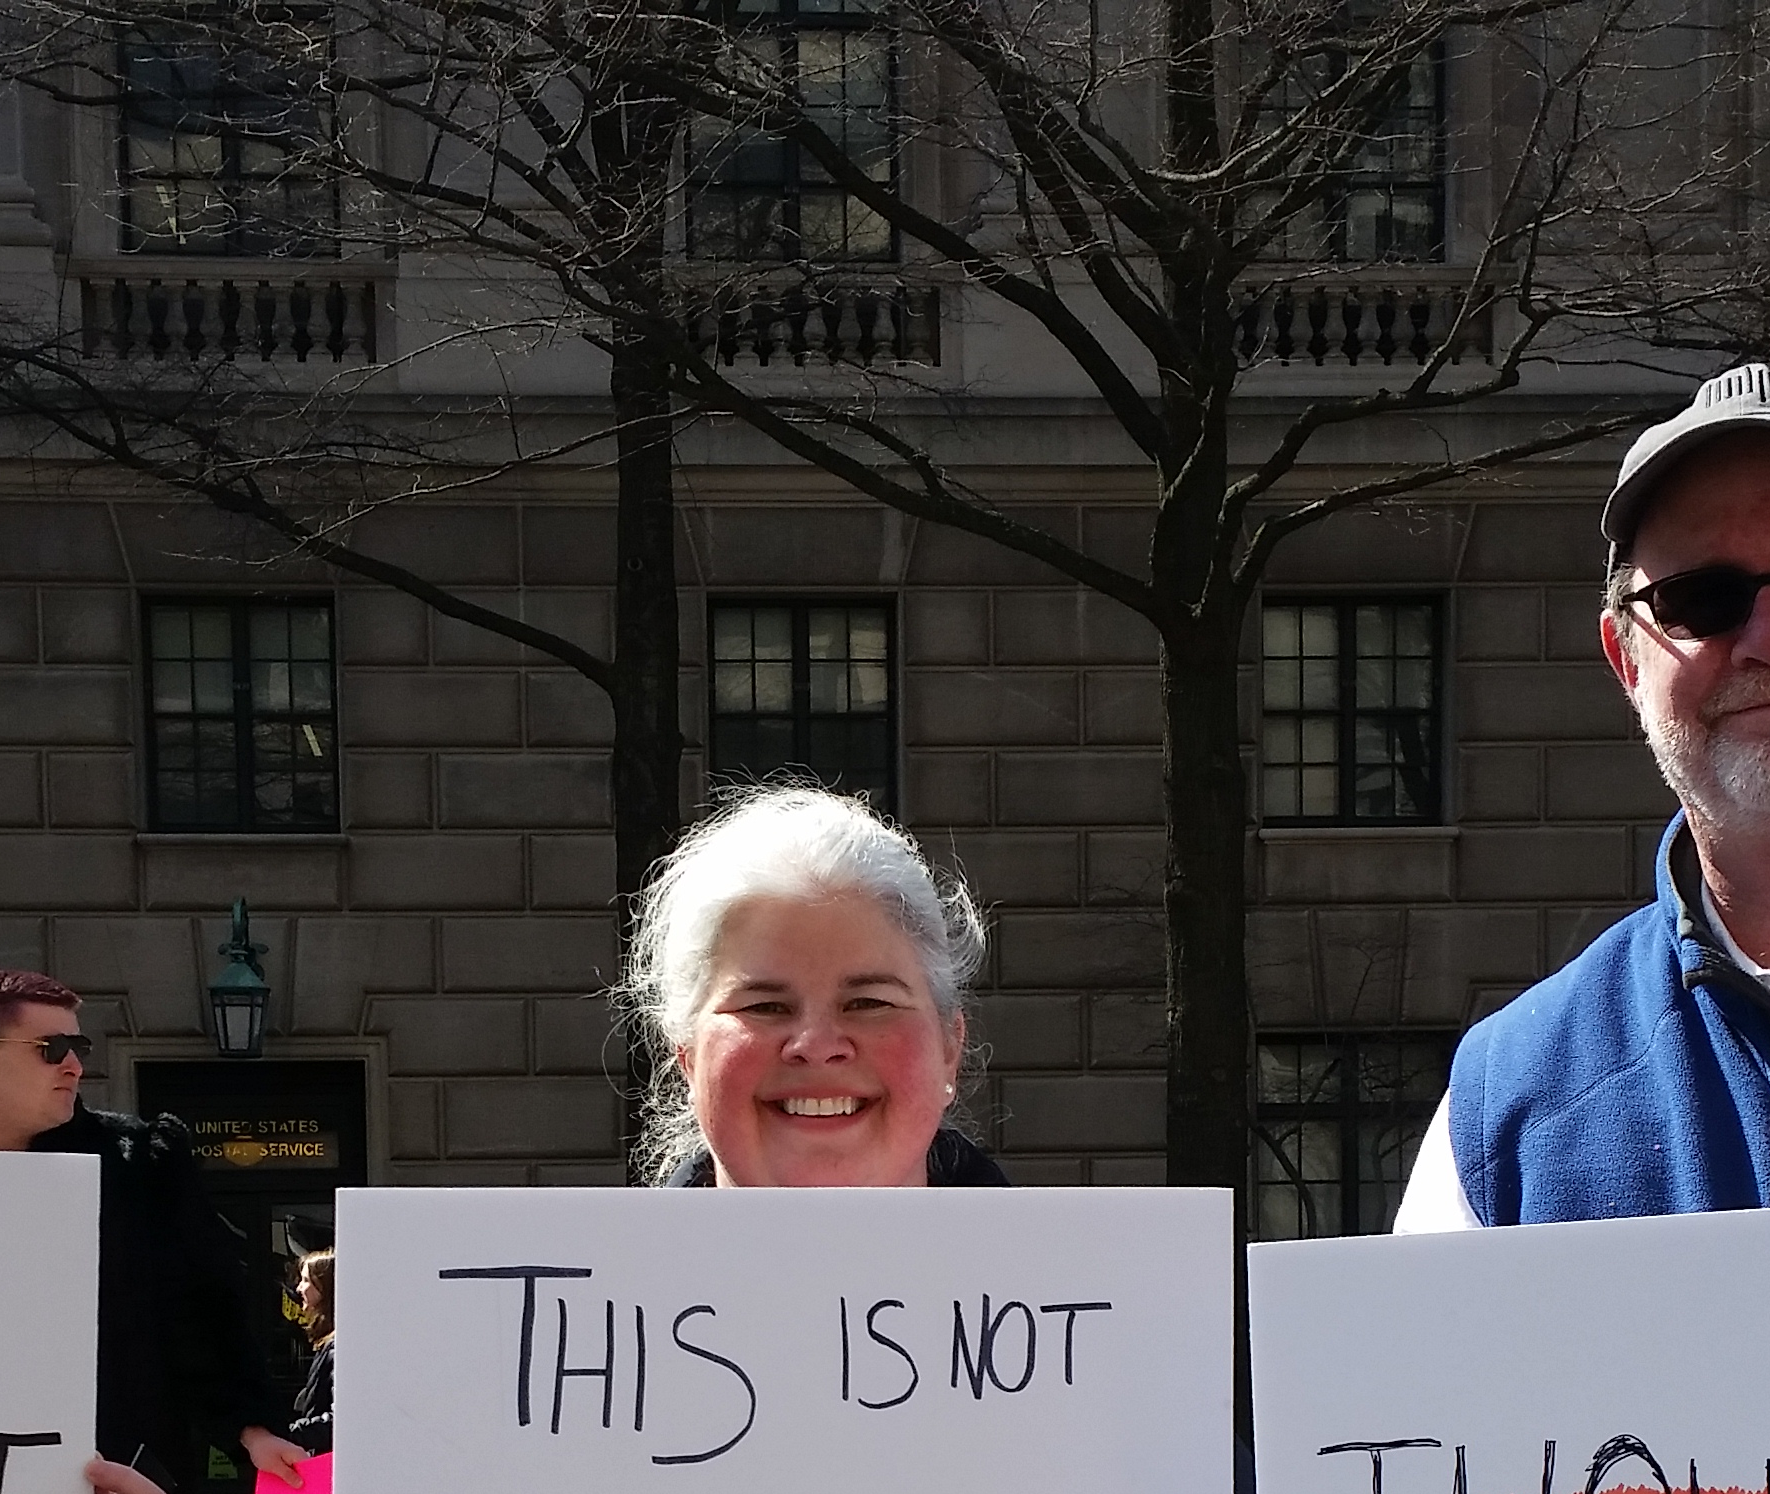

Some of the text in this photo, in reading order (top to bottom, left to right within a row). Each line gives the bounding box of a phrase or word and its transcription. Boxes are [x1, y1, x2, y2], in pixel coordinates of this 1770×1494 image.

[195, 1119, 319, 1134] UNITED STATES
[259, 1142, 325, 1157] SERVICE
[439, 1266, 1112, 1464] THIS IS NOT
